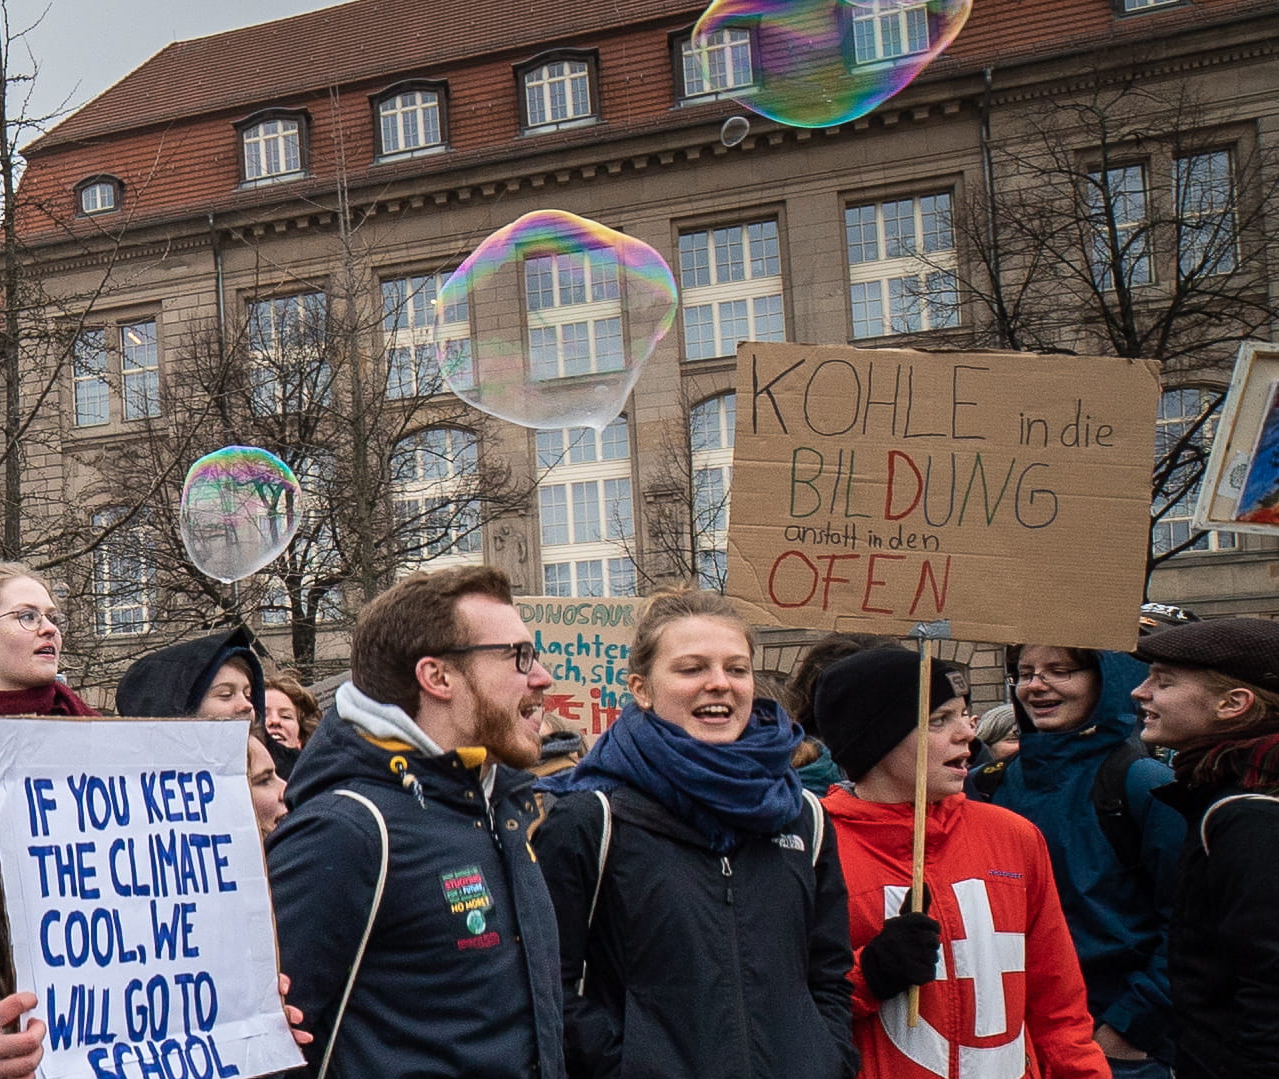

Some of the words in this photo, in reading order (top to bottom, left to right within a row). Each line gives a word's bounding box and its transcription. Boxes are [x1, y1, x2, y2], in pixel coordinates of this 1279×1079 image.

[751, 354, 991, 441] KOHLE
[1019, 411, 1048, 447] in
[1060, 399, 1115, 449] die
[789, 446, 1058, 529] BILDUNG
[784, 523, 857, 549] anstatt
[868, 529, 885, 549] in
[888, 523, 940, 551] den
[768, 550, 951, 615] OFEN
[25, 776, 57, 837] IF
[67, 772, 131, 832] YOU
[140, 770, 215, 824] KEEP
[28, 841, 100, 900] THE
[109, 828, 238, 898] CLIMATE
[40, 907, 146, 968] COOL,
[150, 899, 199, 961] WE
[47, 983, 117, 1052] WILL
[124, 974, 170, 1042] GO
[174, 971, 218, 1038] TO
